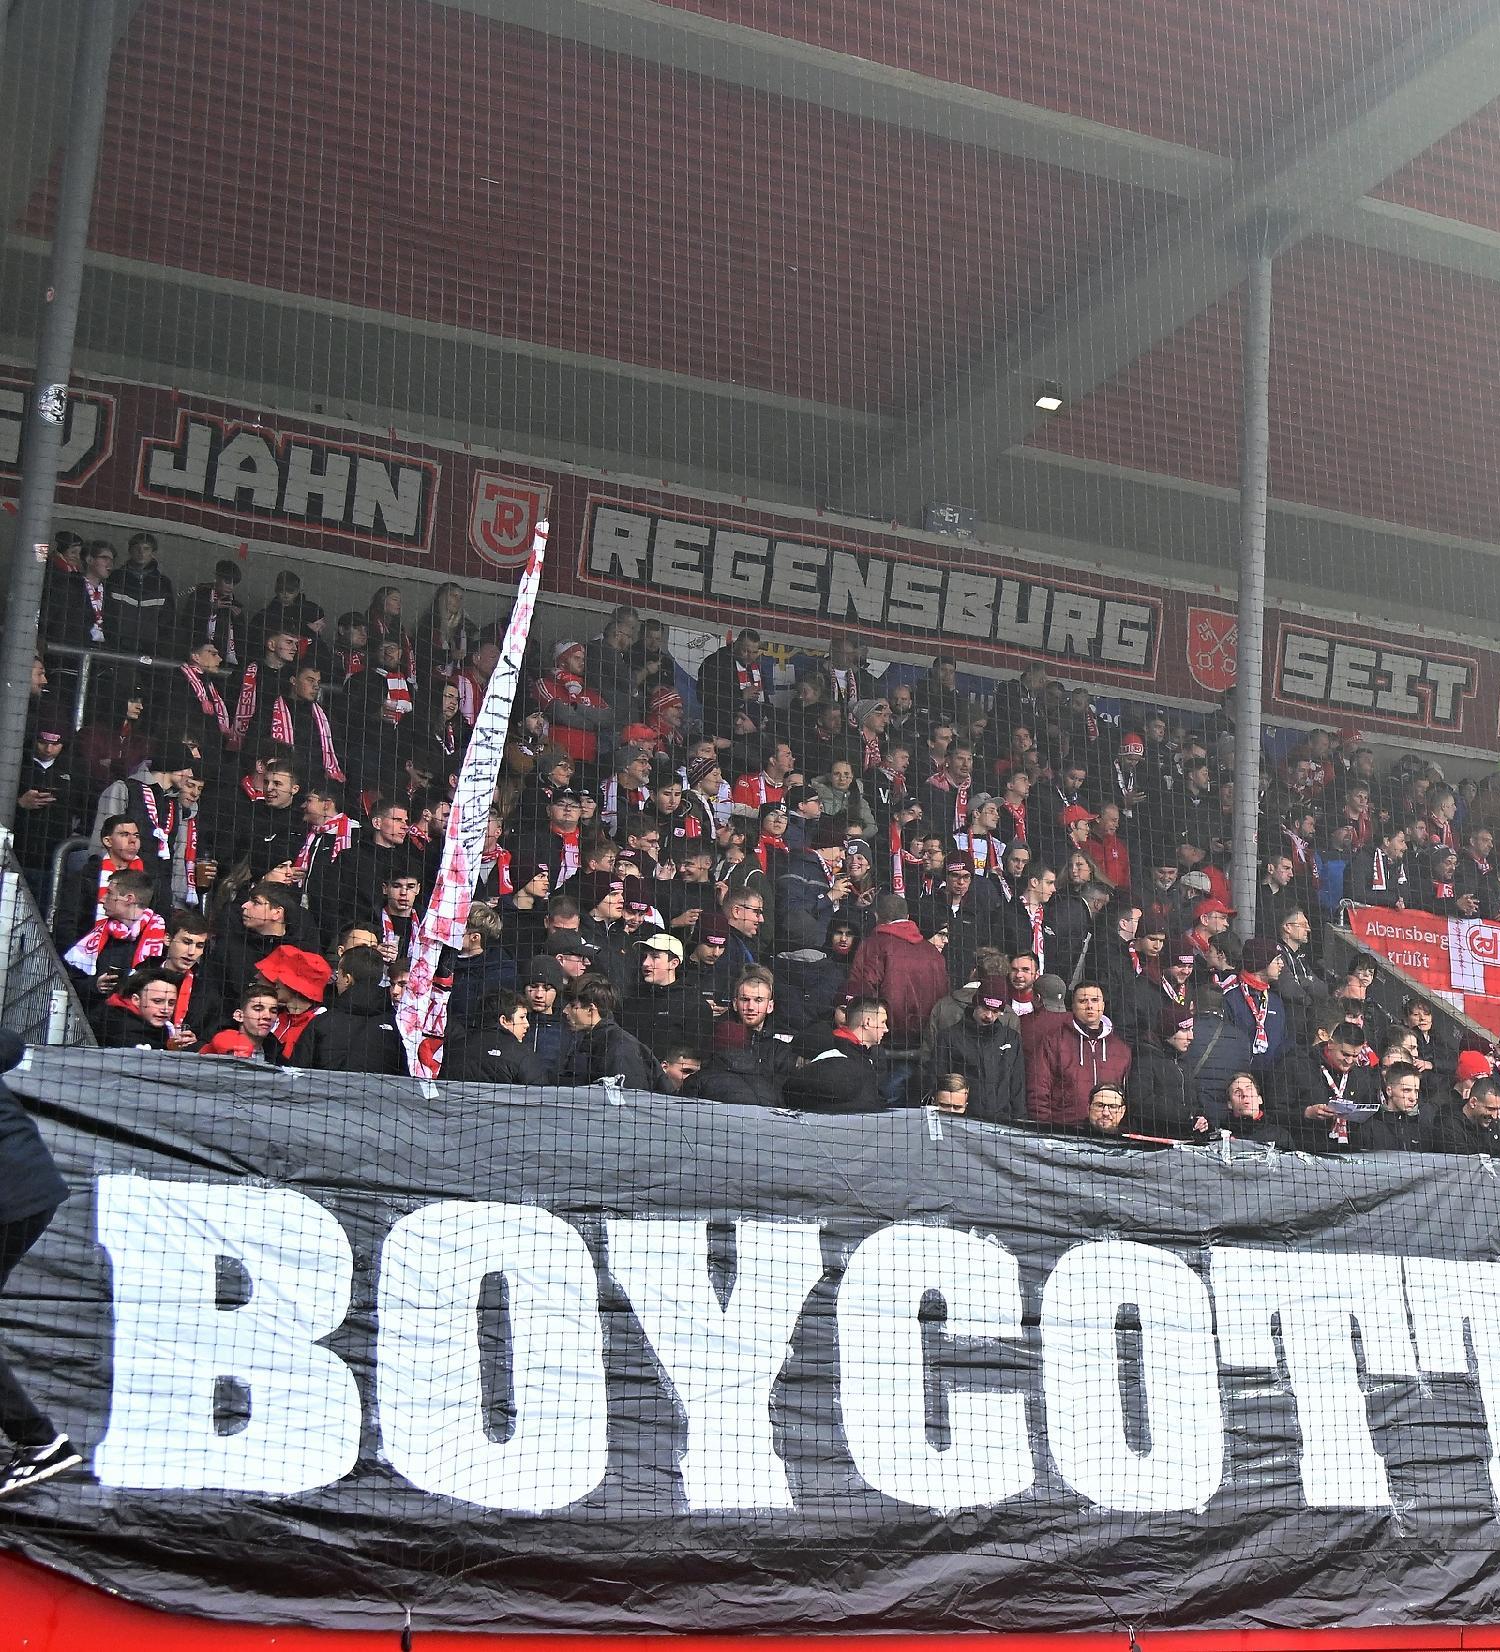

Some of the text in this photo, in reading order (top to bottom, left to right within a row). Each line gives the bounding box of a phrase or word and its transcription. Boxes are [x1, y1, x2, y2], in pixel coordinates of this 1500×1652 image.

[148, 422, 424, 538] JAHN
[591, 507, 1151, 665] REGENSBURG
[1282, 634, 1472, 721] SEIT
[1366, 921, 1449, 949] Abensberg
